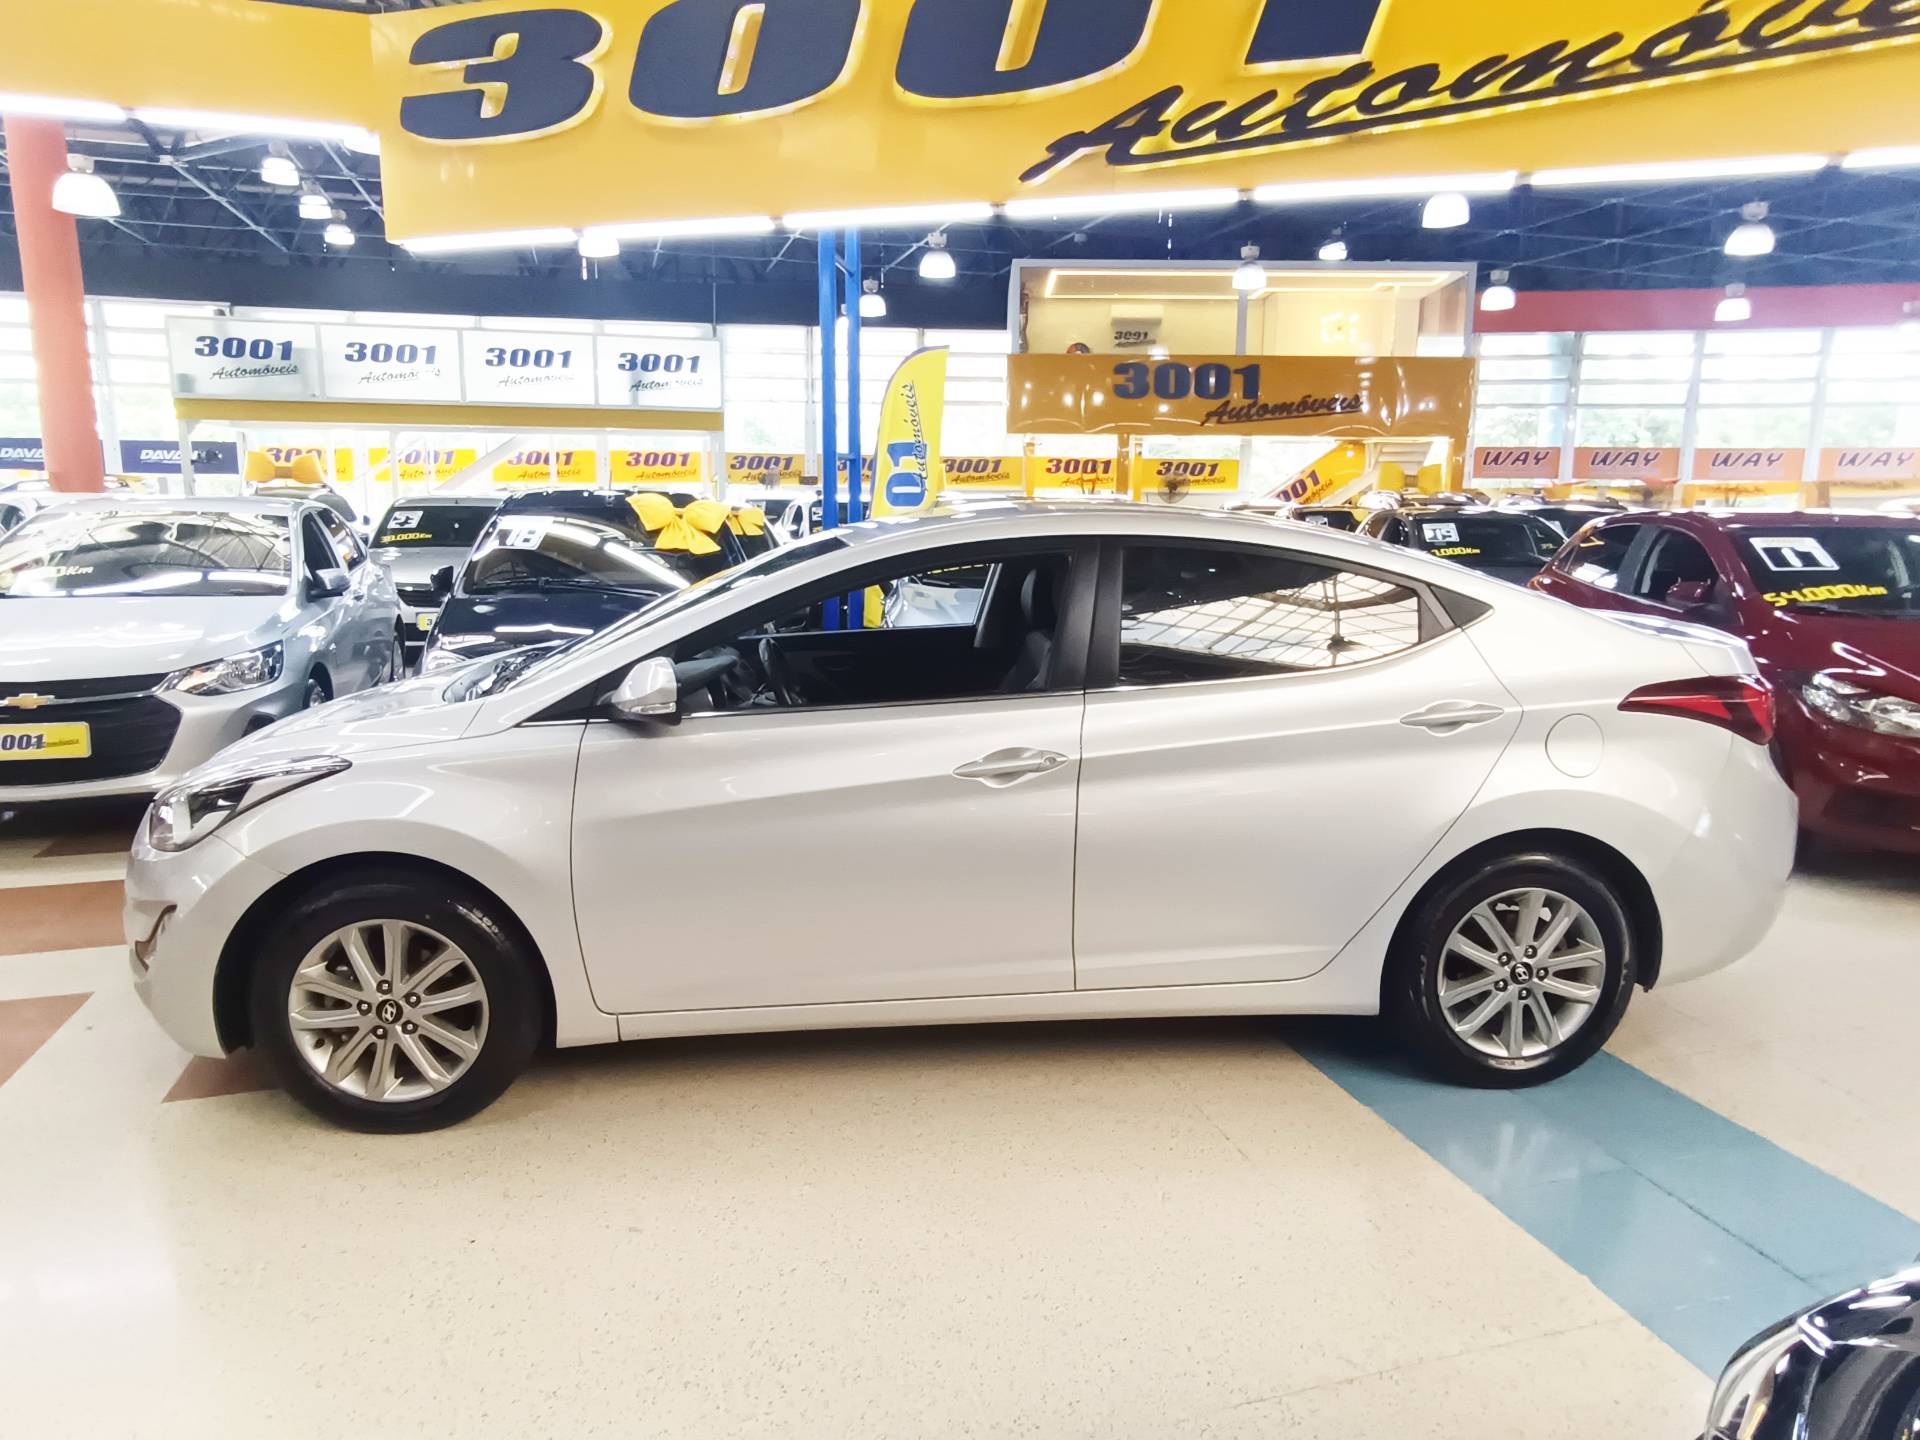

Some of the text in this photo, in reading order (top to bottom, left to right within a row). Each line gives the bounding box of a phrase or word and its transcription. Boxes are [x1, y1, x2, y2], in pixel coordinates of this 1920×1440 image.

[195, 335, 293, 361] 3001
[344, 342, 436, 365] 3001
[485, 347, 572, 369] 3001
[617, 352, 701, 374] 3001
[209, 363, 300, 380] Automóveis
[1113, 363, 1260, 400] 3001
[1199, 394, 1362, 427] Automóveis
[507, 451, 574, 466] 3001
[626, 452, 690, 467] 3001
[730, 456, 793, 470] 3001
[943, 458, 1001, 473] 3001
[1046, 459, 1112, 474] 3001
[1482, 451, 1550, 466] WAY
[1590, 451, 1660, 467] WAY
[1712, 452, 1784, 467] WAY
[1838, 452, 1914, 467] WAY
[1156, 461, 1219, 477] 3001
